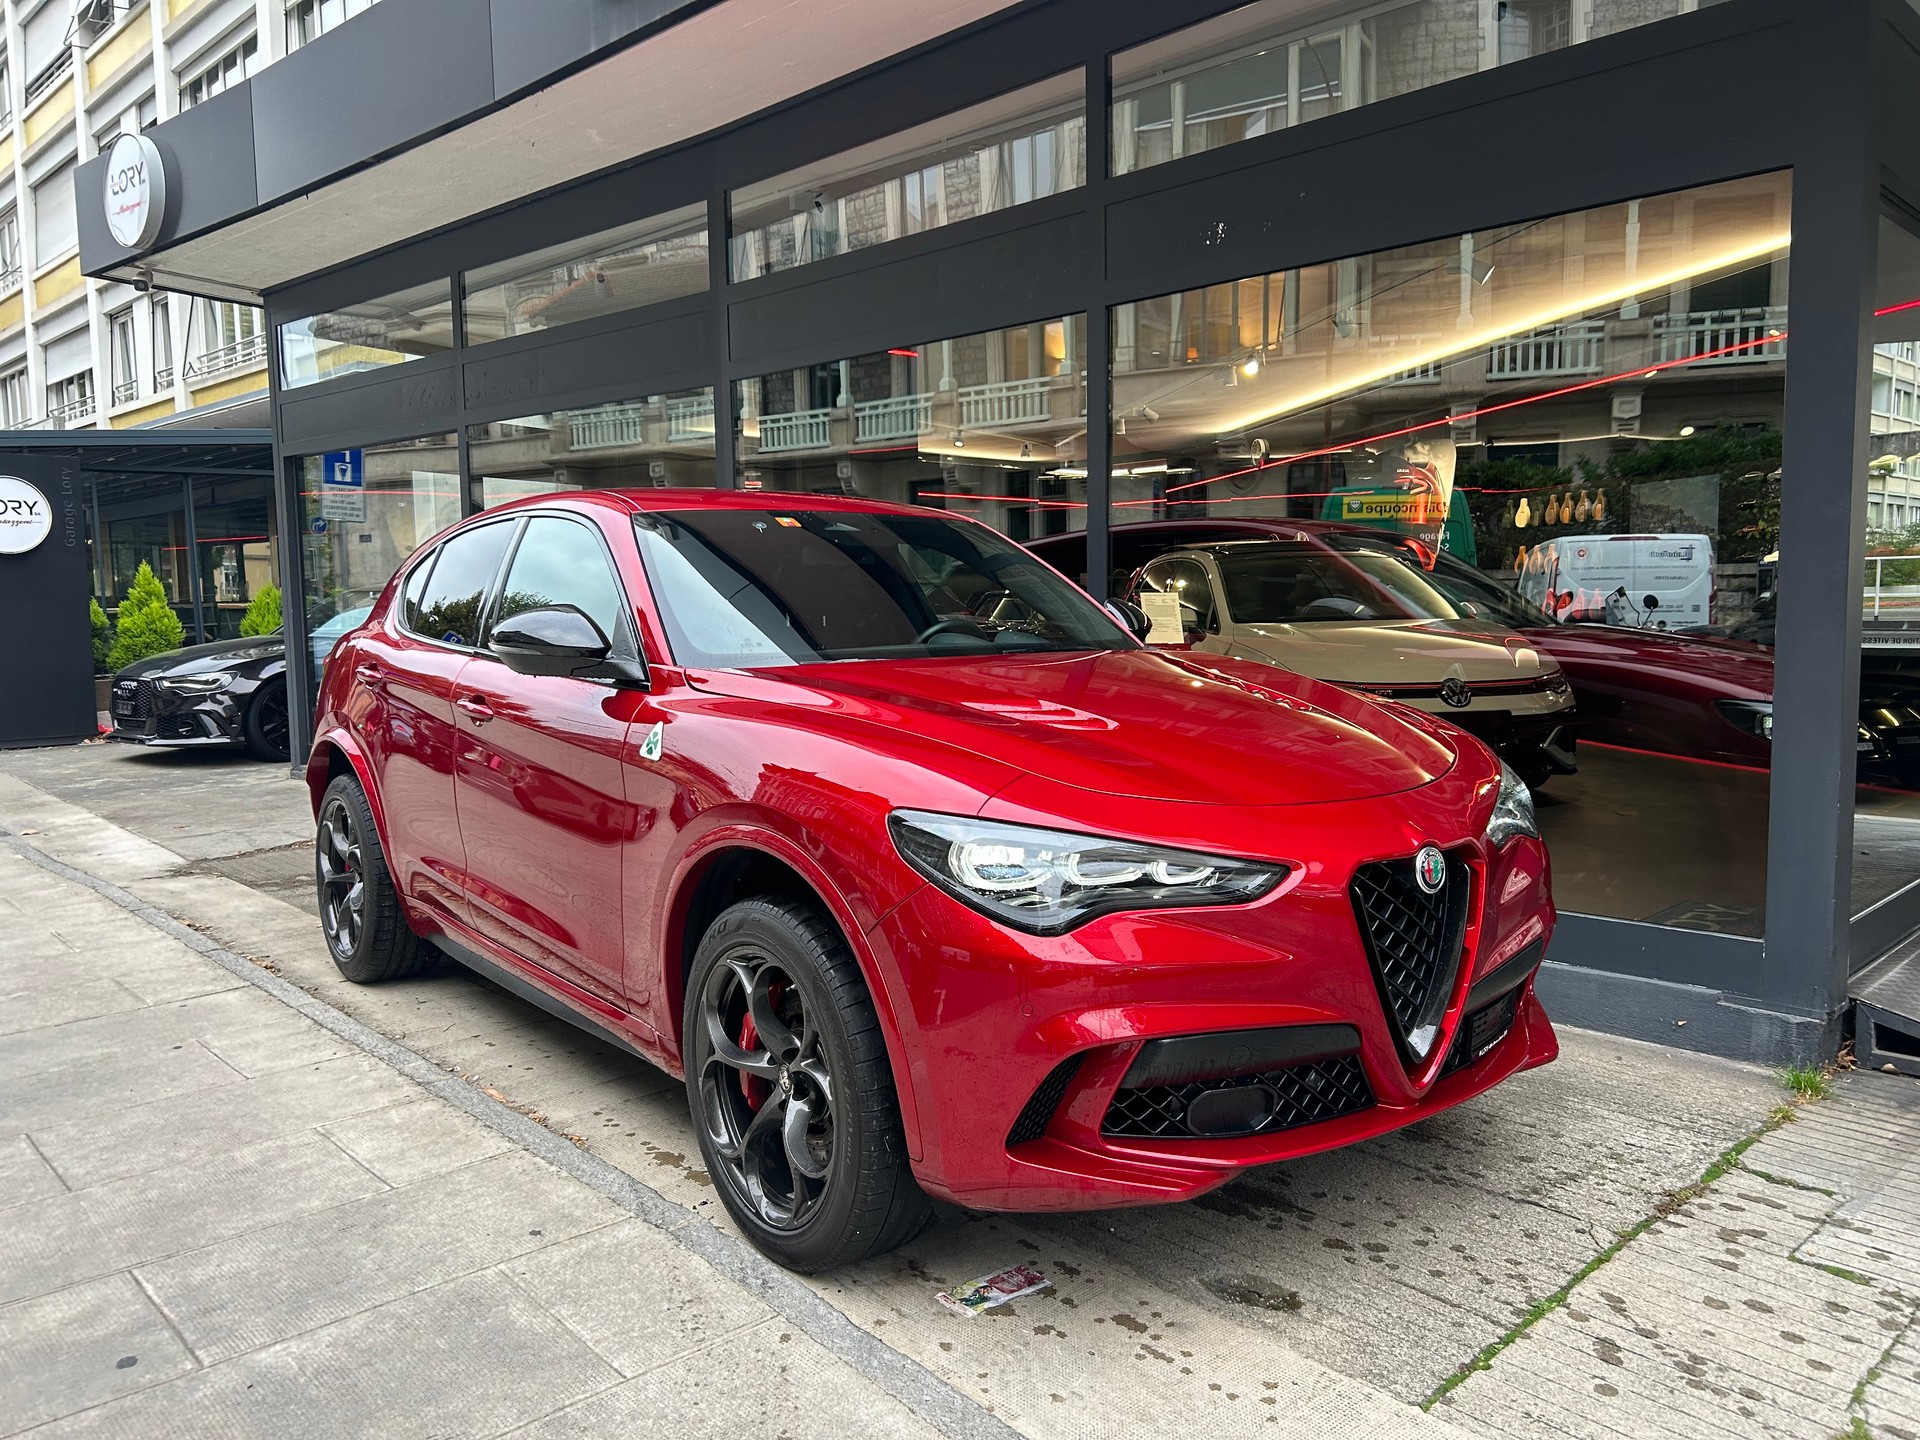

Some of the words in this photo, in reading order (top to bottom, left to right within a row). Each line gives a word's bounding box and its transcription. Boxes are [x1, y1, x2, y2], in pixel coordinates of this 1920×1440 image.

[111, 161, 144, 195] LORY
[61, 467, 74, 495] Lory
[64, 499, 76, 547] Garage
